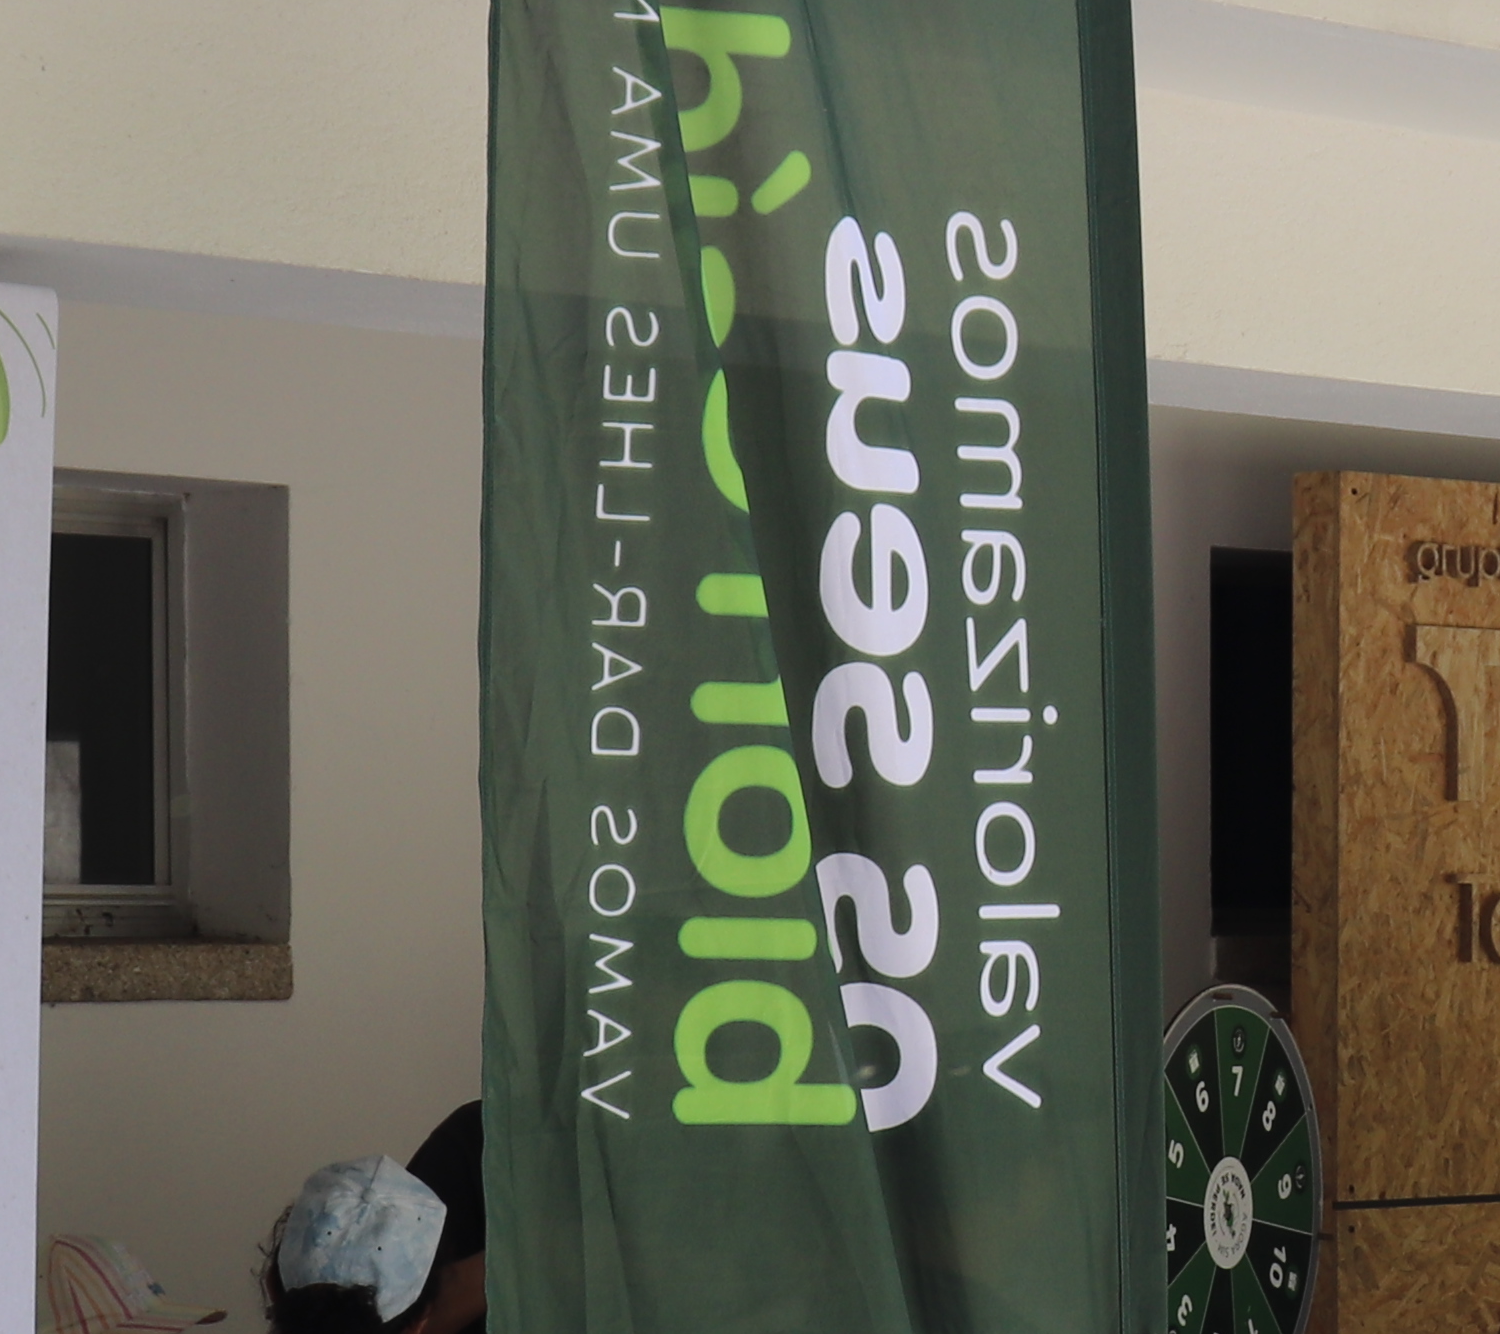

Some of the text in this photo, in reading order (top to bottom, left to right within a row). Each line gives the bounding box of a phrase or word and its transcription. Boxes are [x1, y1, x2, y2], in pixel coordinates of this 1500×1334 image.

[1195, 1080, 1210, 1113] 6
[1231, 1065, 1244, 1097] 7
[1262, 1100, 1277, 1132] 8
[1168, 1139, 1185, 1169] 5
[1277, 1173, 1293, 1200] 9
[1269, 1246, 1287, 1288] 10
[1177, 1294, 1193, 1327] 3
